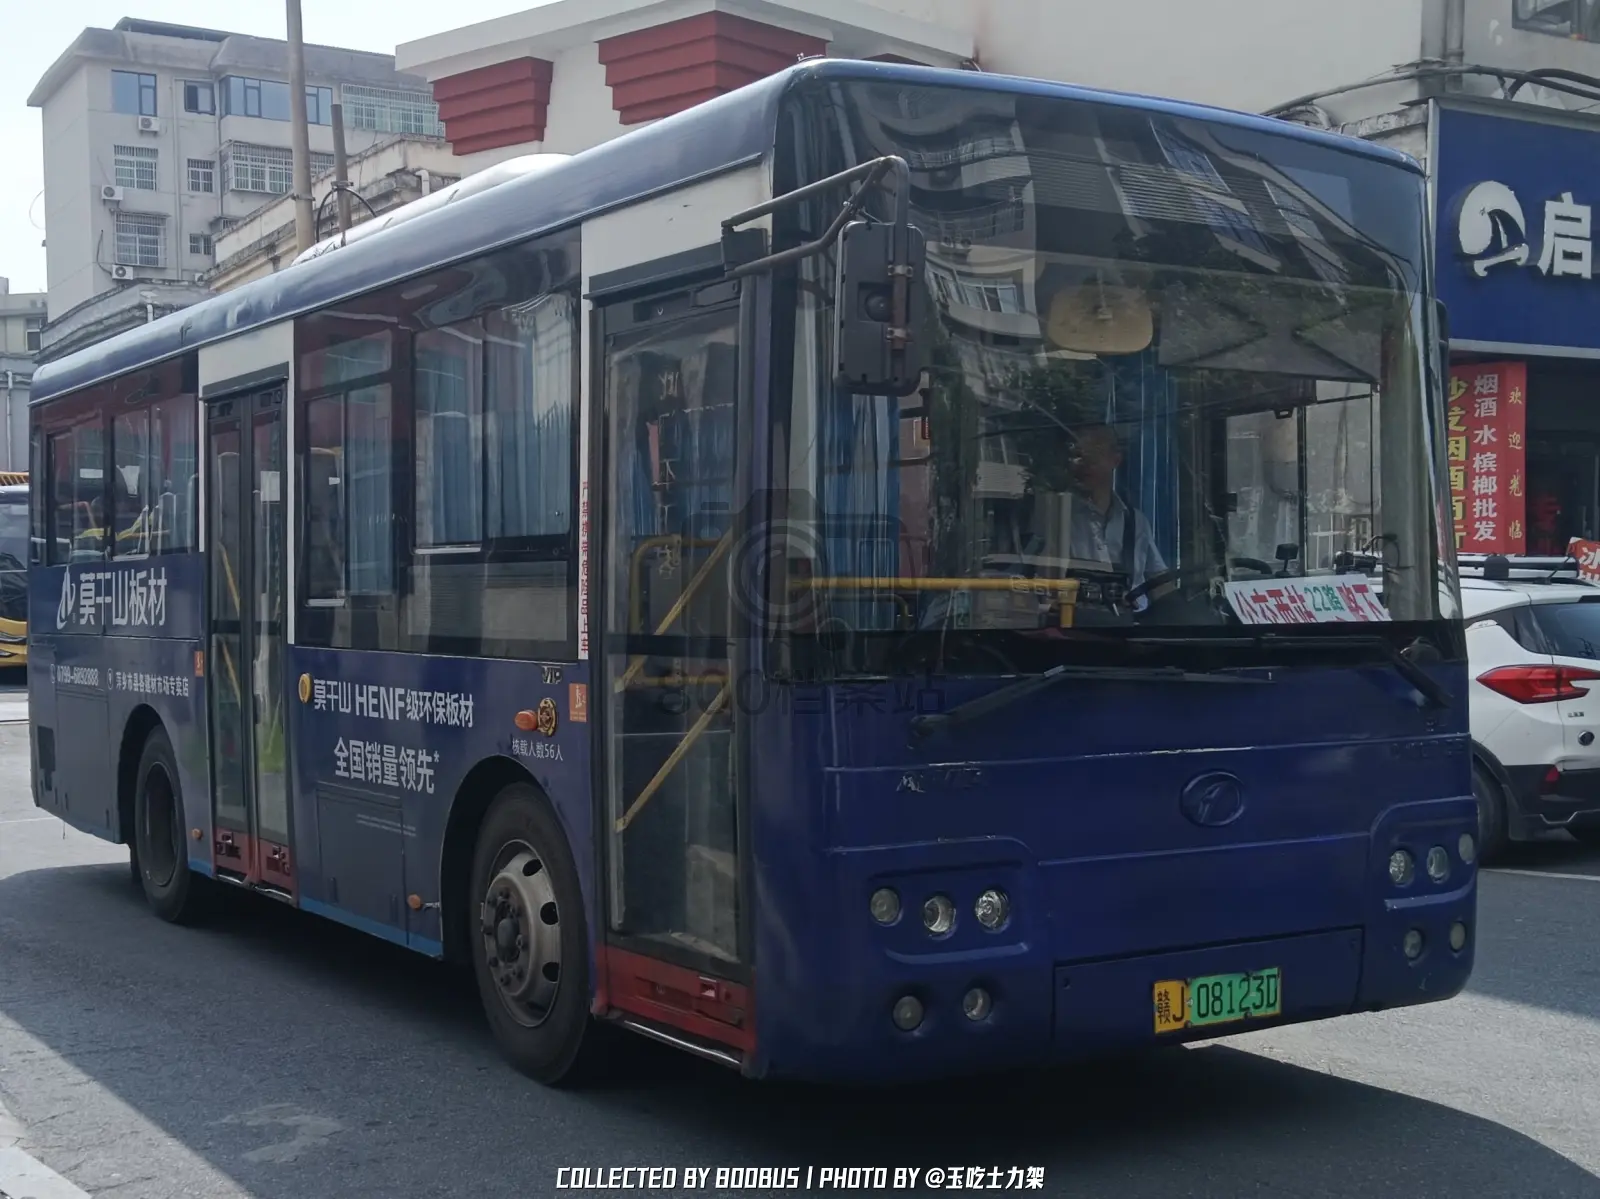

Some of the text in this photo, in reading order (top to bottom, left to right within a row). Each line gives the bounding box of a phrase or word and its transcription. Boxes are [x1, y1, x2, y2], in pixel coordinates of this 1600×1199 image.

[1538, 191, 1592, 279] 启
[80, 567, 167, 626] 莫干山板材
[511, 738, 563, 762] 核载人数56人
